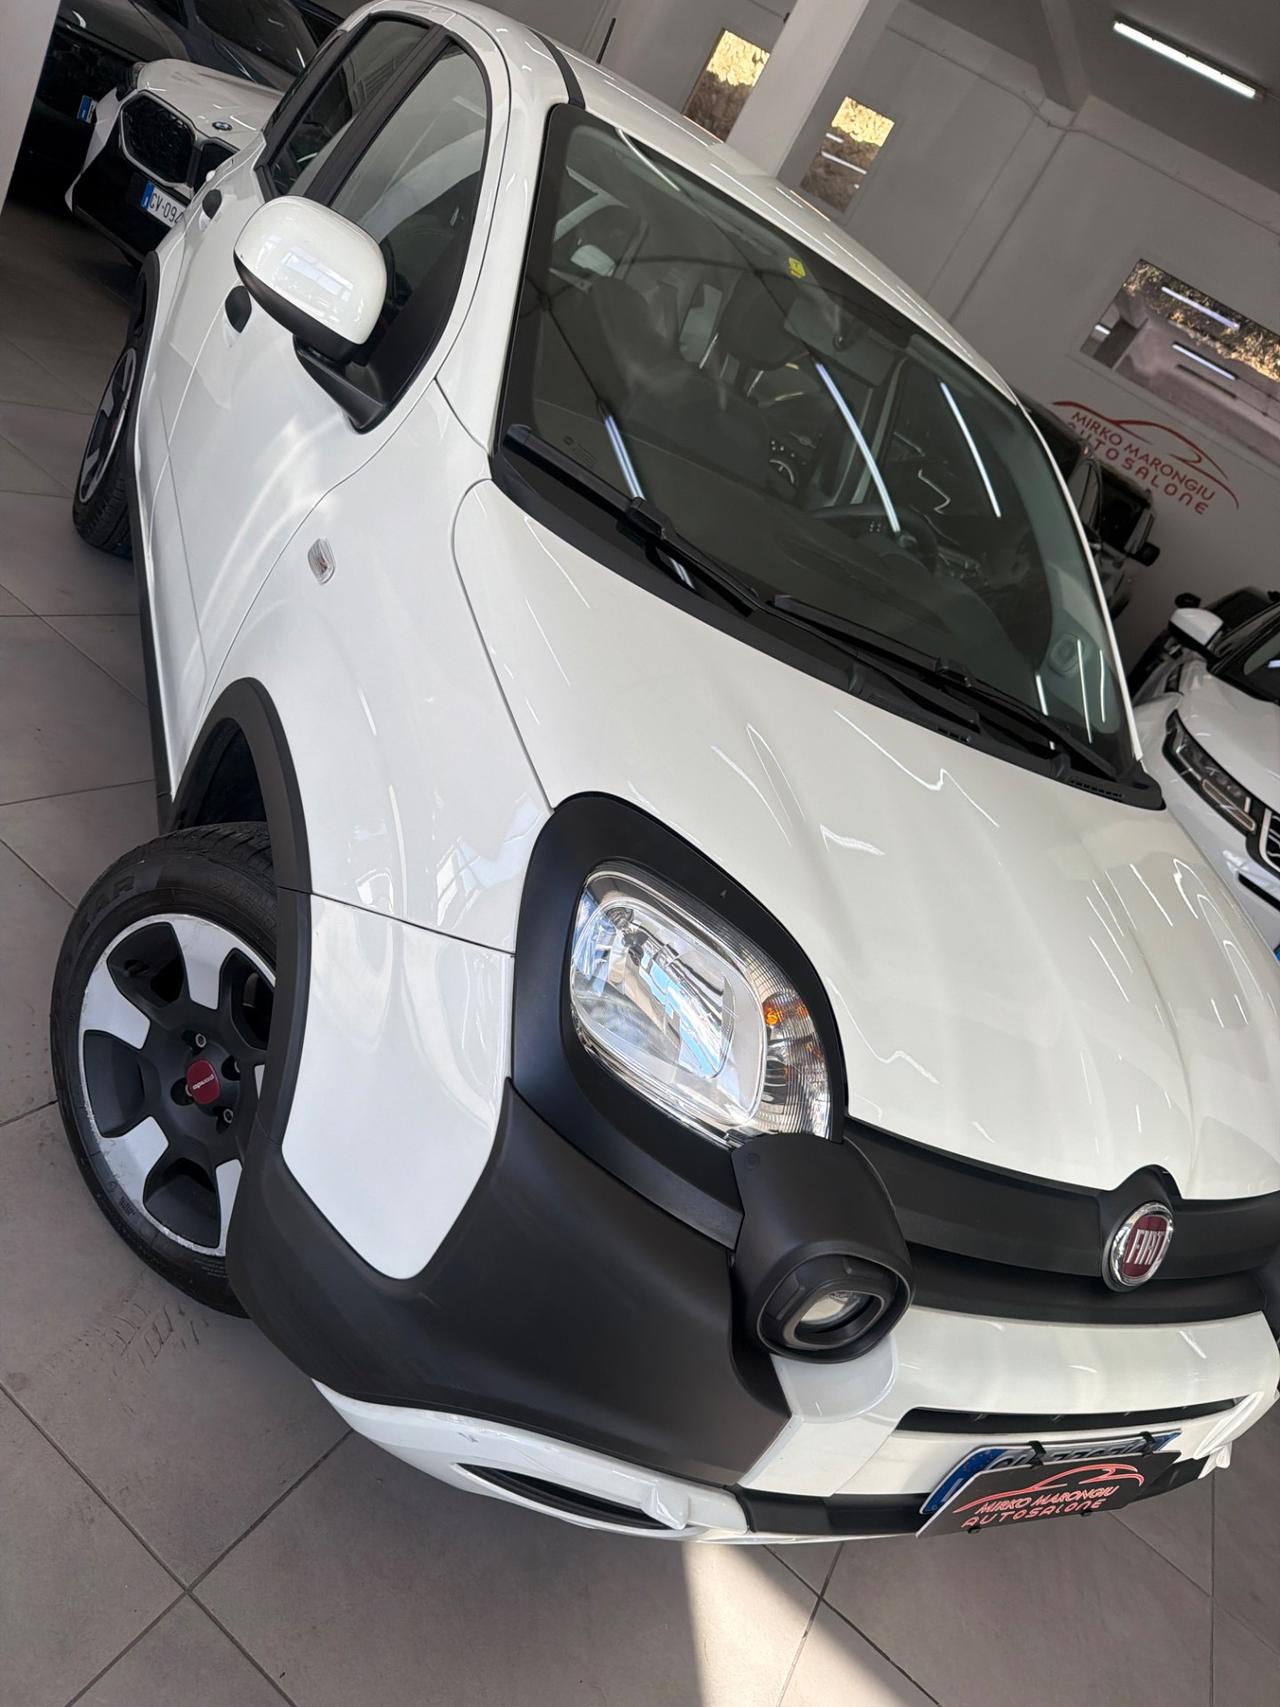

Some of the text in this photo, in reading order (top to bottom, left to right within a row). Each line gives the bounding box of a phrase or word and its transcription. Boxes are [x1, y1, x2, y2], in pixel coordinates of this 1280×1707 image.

[1072, 411, 1216, 501] MIRKO MARONGIU
[1126, 1228, 1166, 1265] FIAT
[960, 1498, 1107, 1528] AUTOSALONE
[974, 1485, 1120, 1515] MIRKO MARONGIU
